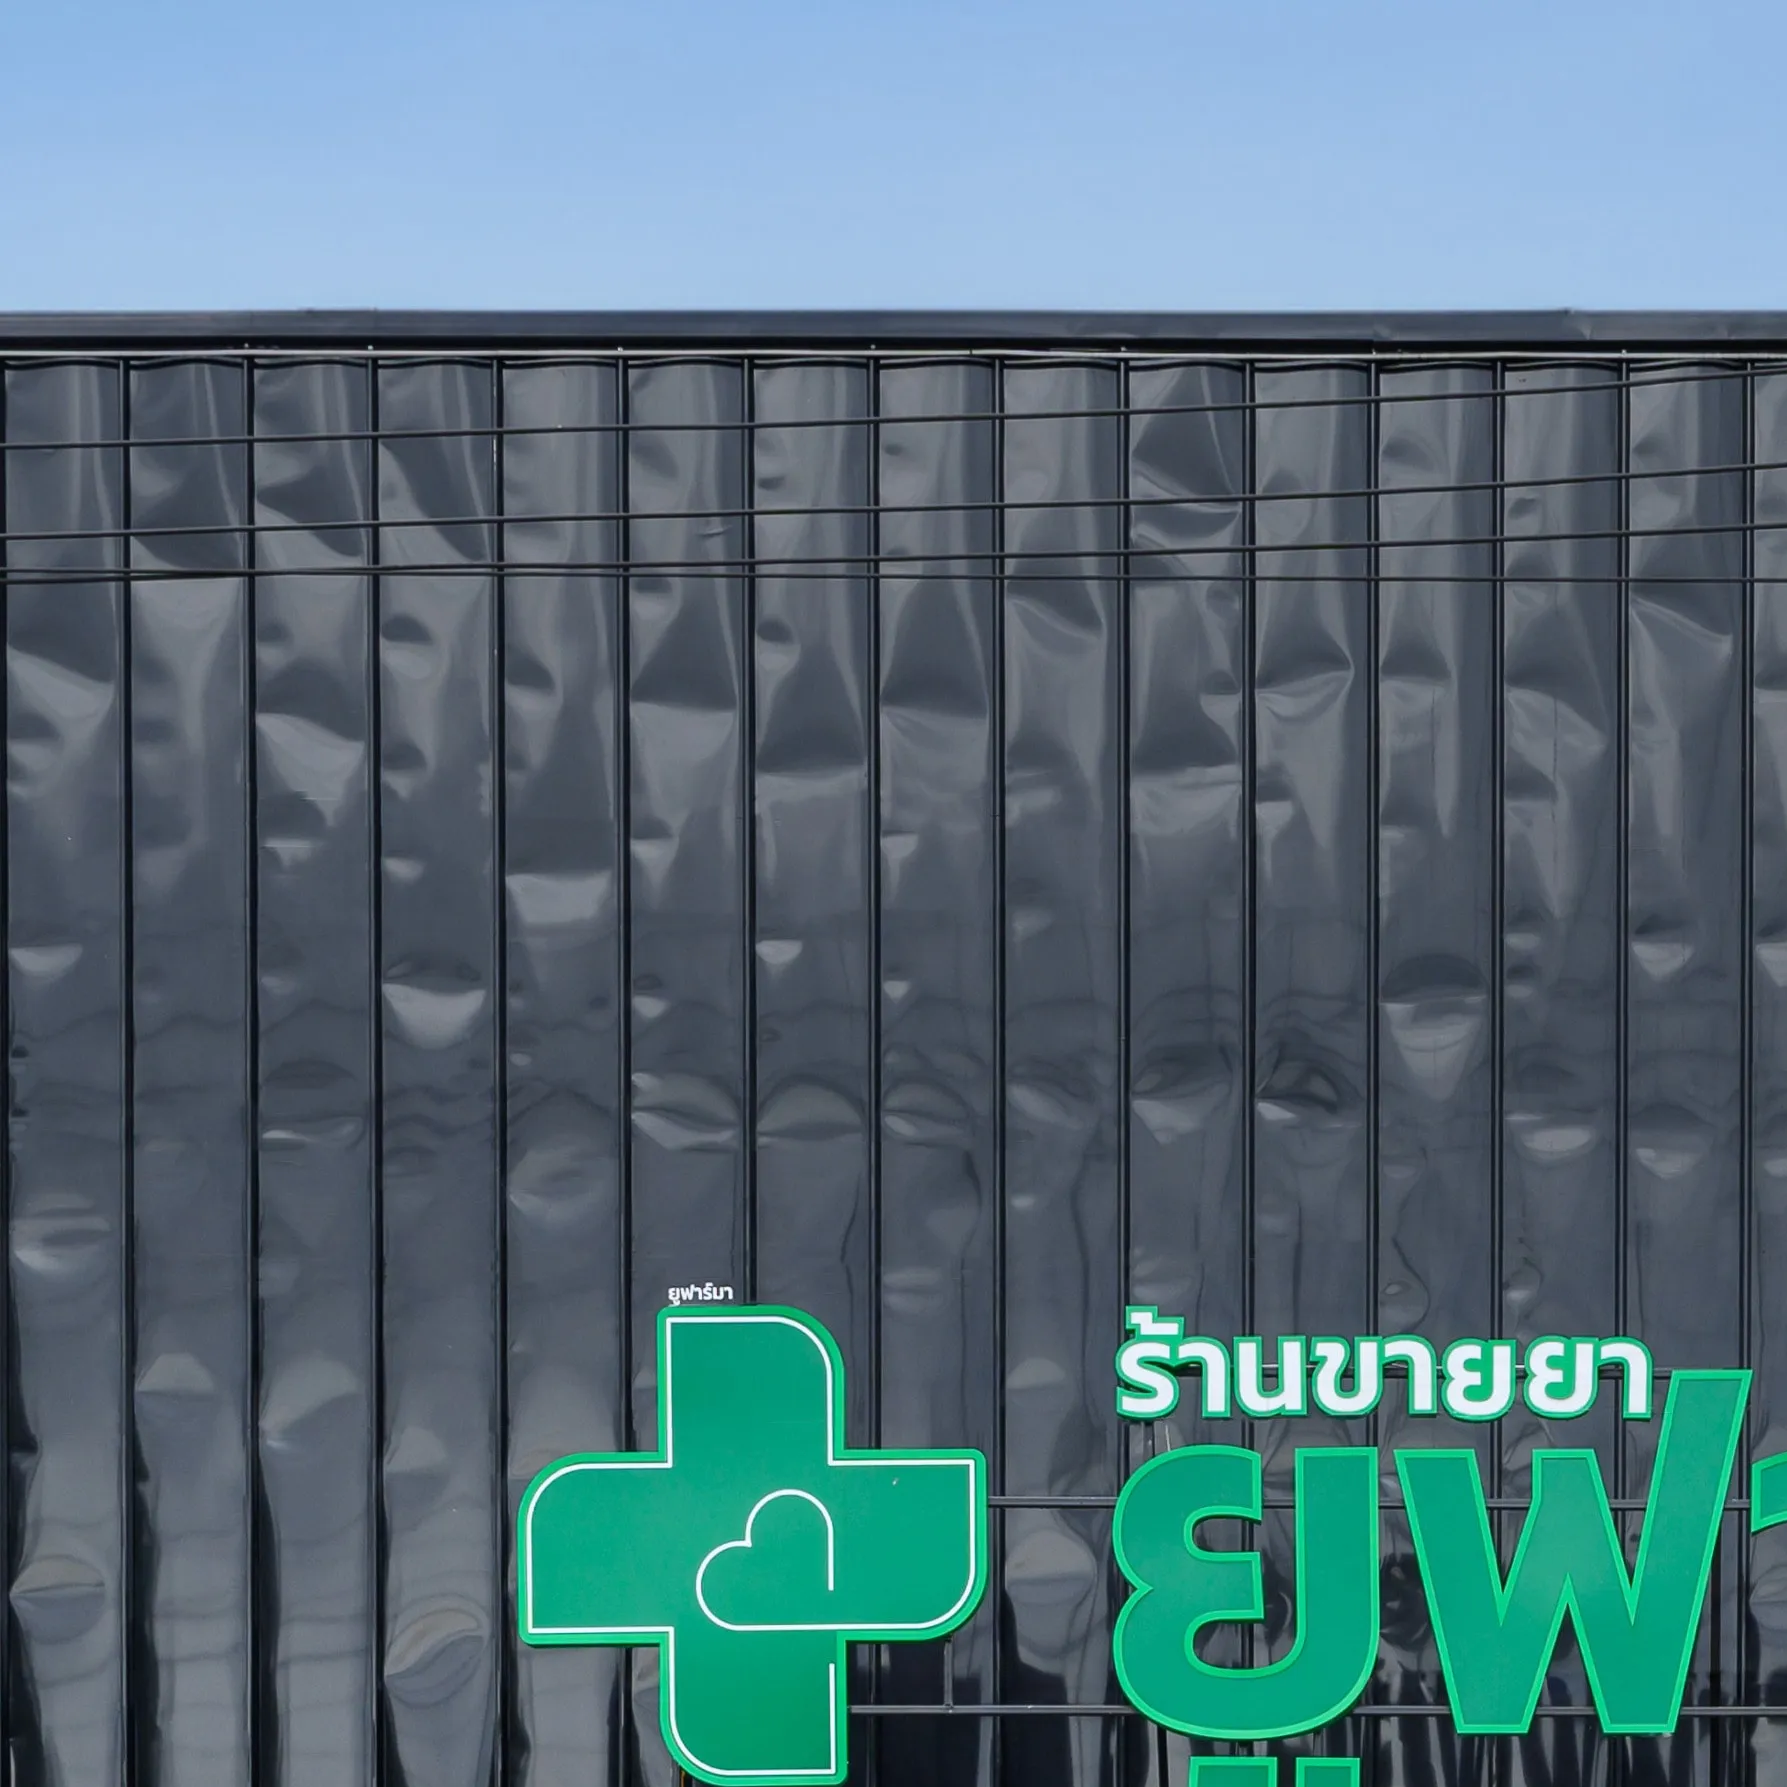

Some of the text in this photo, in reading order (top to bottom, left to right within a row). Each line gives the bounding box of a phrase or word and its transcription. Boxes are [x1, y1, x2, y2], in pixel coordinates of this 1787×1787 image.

[667, 1282, 734, 1306] ยูฟาร์มา
[1116, 1304, 1653, 1421] ร้านขายยา
